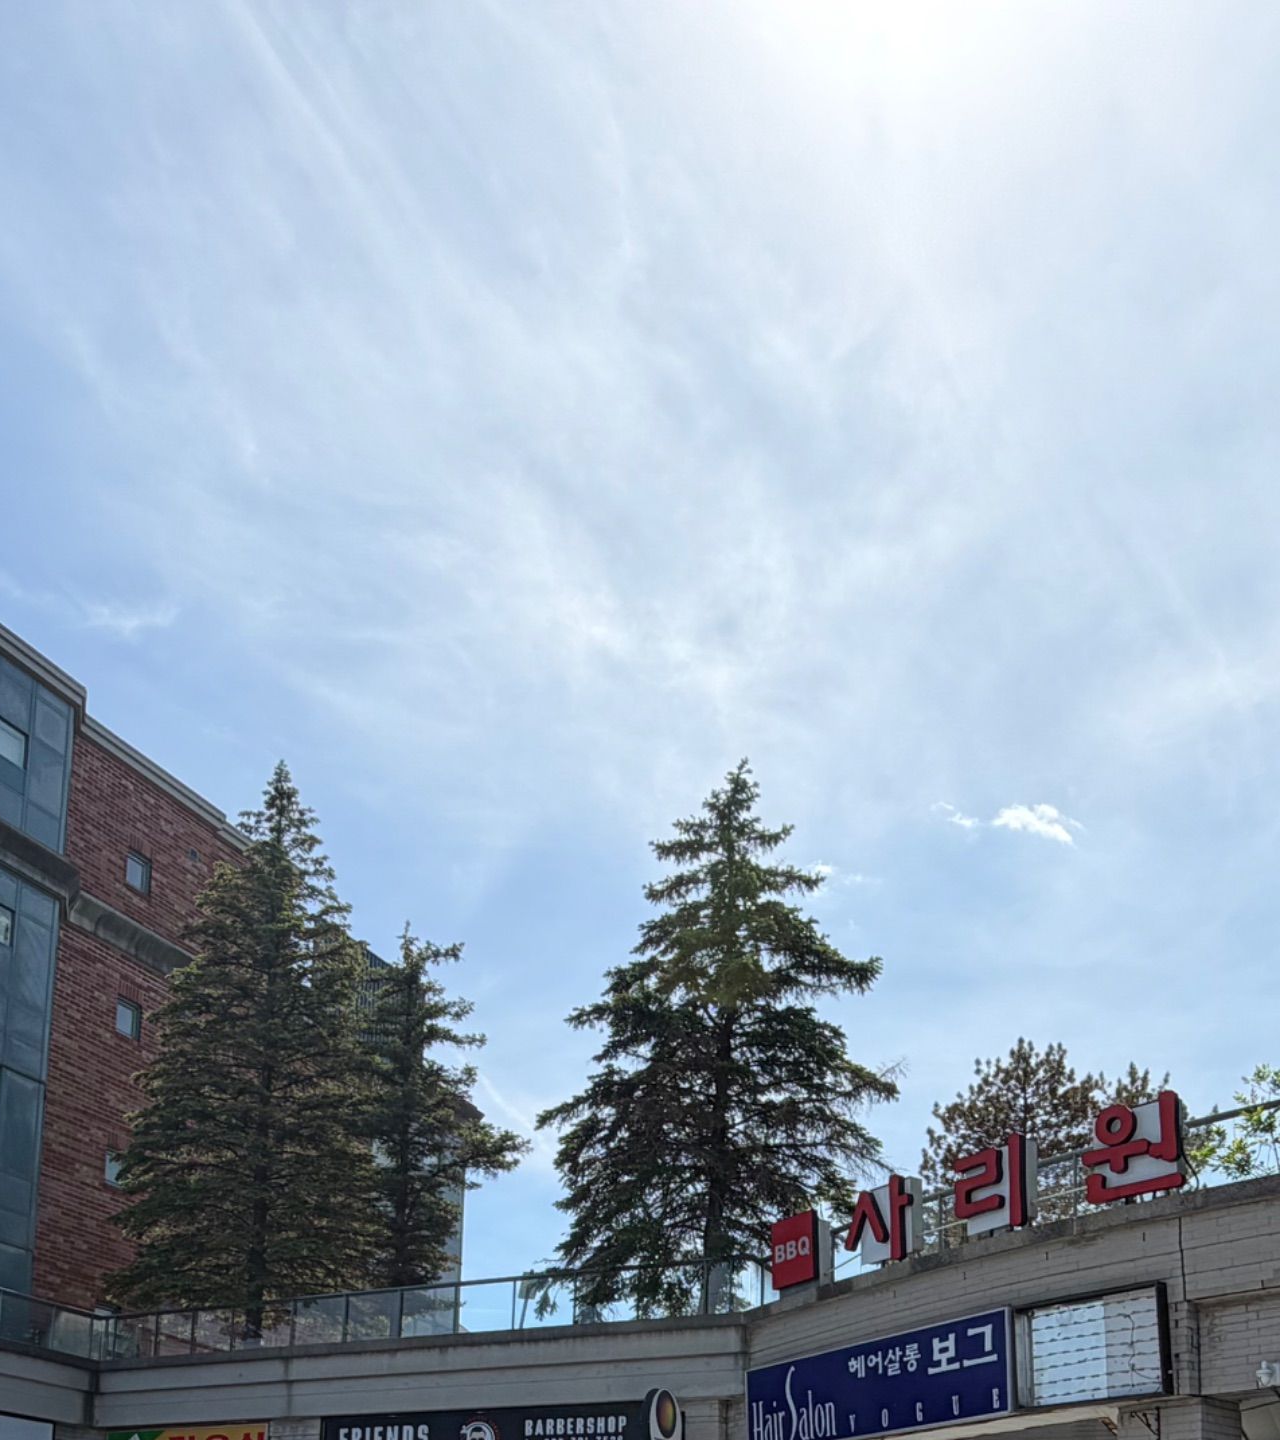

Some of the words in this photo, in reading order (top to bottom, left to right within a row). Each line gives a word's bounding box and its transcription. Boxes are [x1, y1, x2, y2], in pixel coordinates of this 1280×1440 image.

[844, 1090, 1187, 1260] 사리원
[773, 1237, 811, 1266] BBQ
[847, 1342, 922, 1379] 헤어살롱
[927, 1323, 999, 1376] 보그
[524, 1415, 628, 1437] BARBERSHOP
[848, 1387, 1001, 1433] VOGUE
